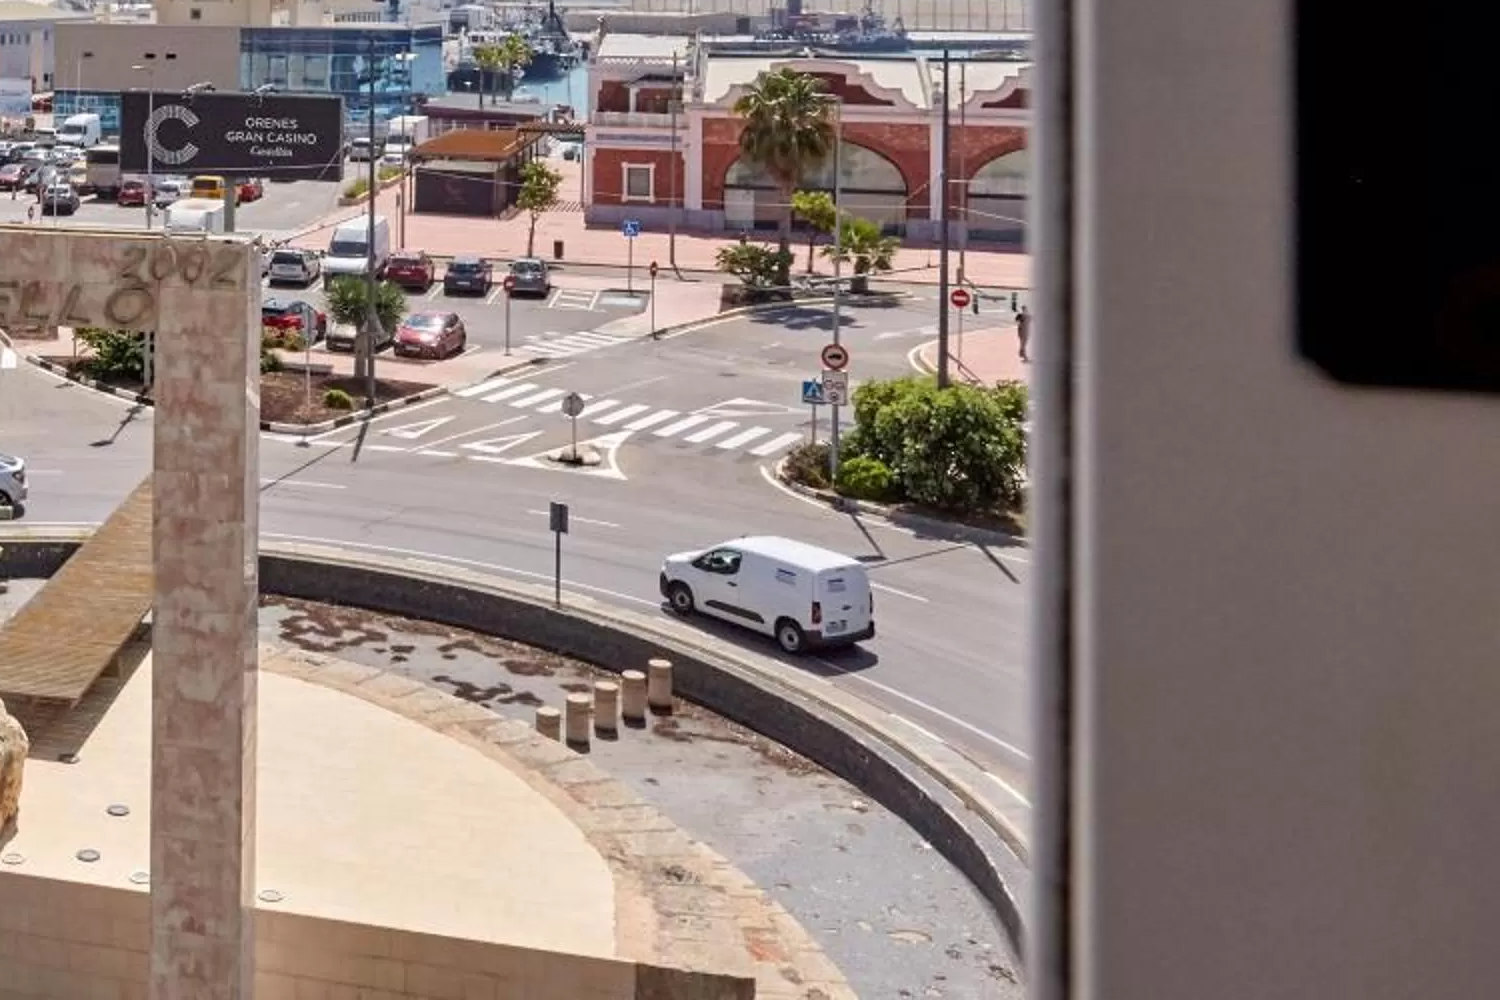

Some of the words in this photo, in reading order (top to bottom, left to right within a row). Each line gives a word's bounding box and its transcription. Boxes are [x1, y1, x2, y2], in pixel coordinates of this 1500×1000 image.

[245, 117, 299, 130] ORENES
[225, 131, 264, 143] GRAN
[267, 132, 317, 145] CASINO
[120, 240, 244, 289] 2002
